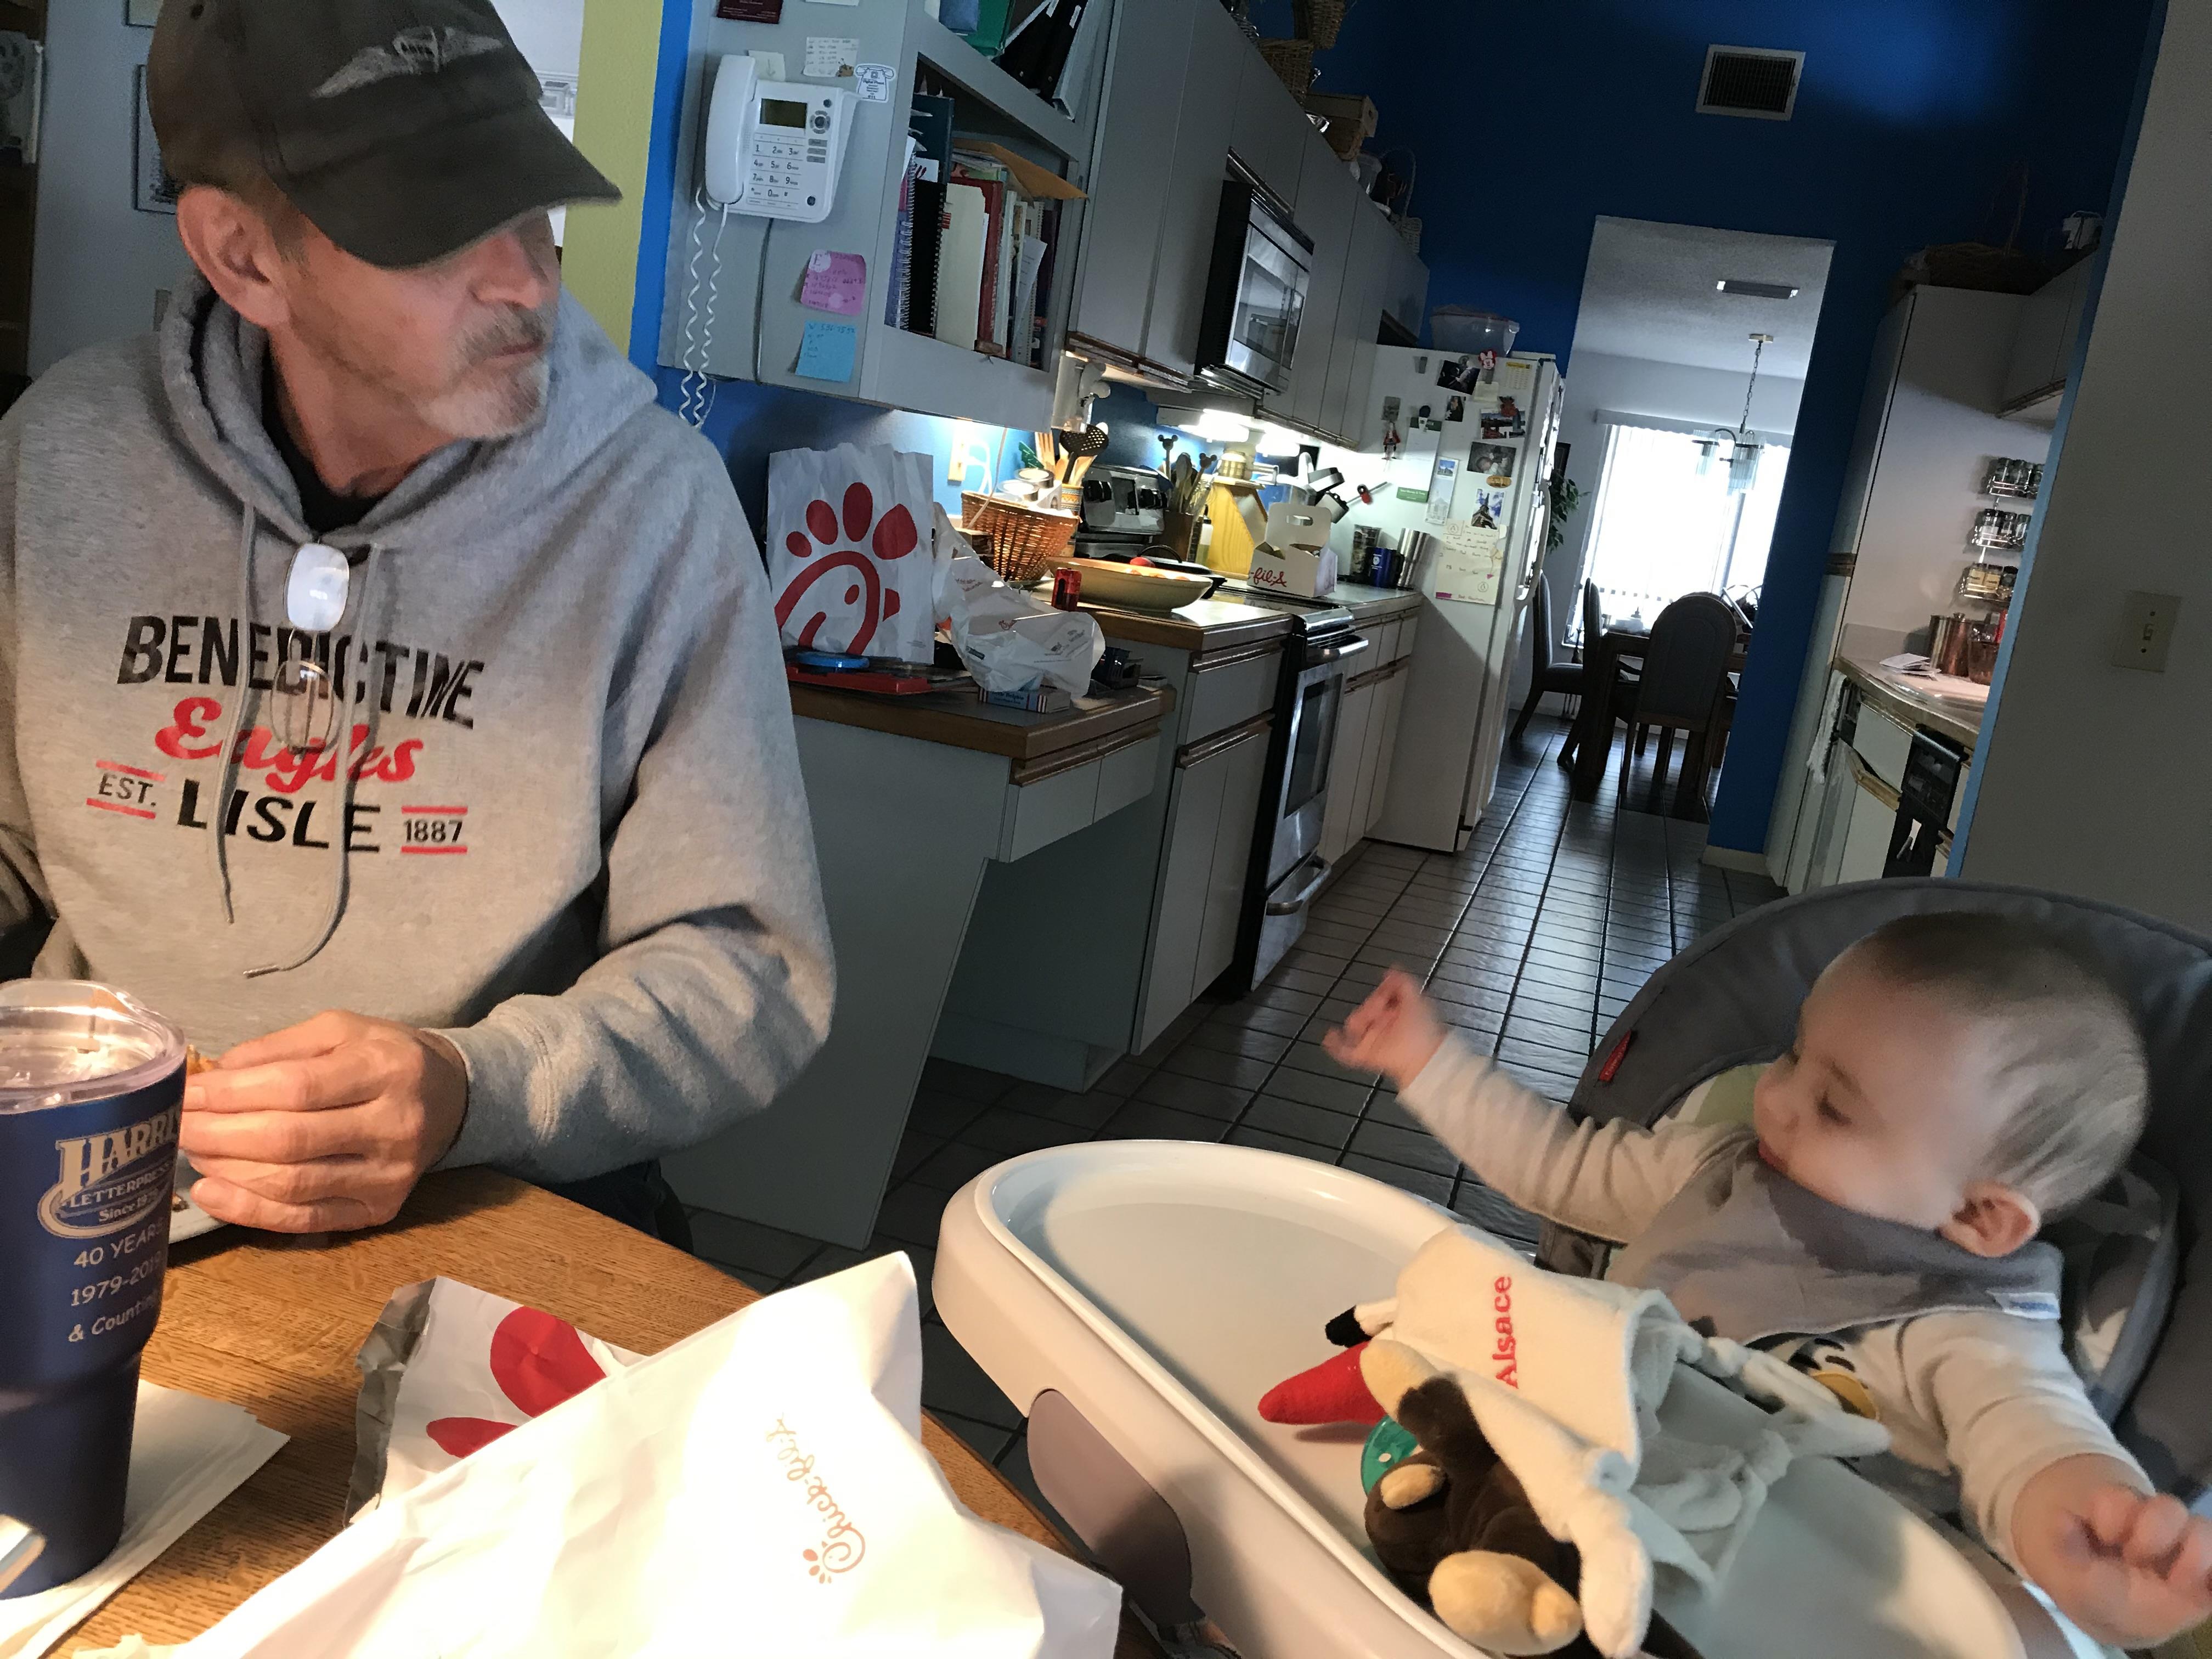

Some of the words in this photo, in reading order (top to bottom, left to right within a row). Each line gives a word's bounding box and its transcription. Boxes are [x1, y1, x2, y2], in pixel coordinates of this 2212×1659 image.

[116, 615, 485, 730] BENEDICTINE
[154, 697, 424, 793] Eagles
[98, 774, 157, 808] EST.
[177, 778, 381, 853] LISLE
[404, 819, 464, 844] 1887
[98, 1201, 136, 1223] Since
[73, 1246, 104, 1268] 40
[68, 1323, 84, 1342] &
[1492, 1276, 1519, 1390] Alsace
[766, 1412, 866, 1575] Chick-fil-A
